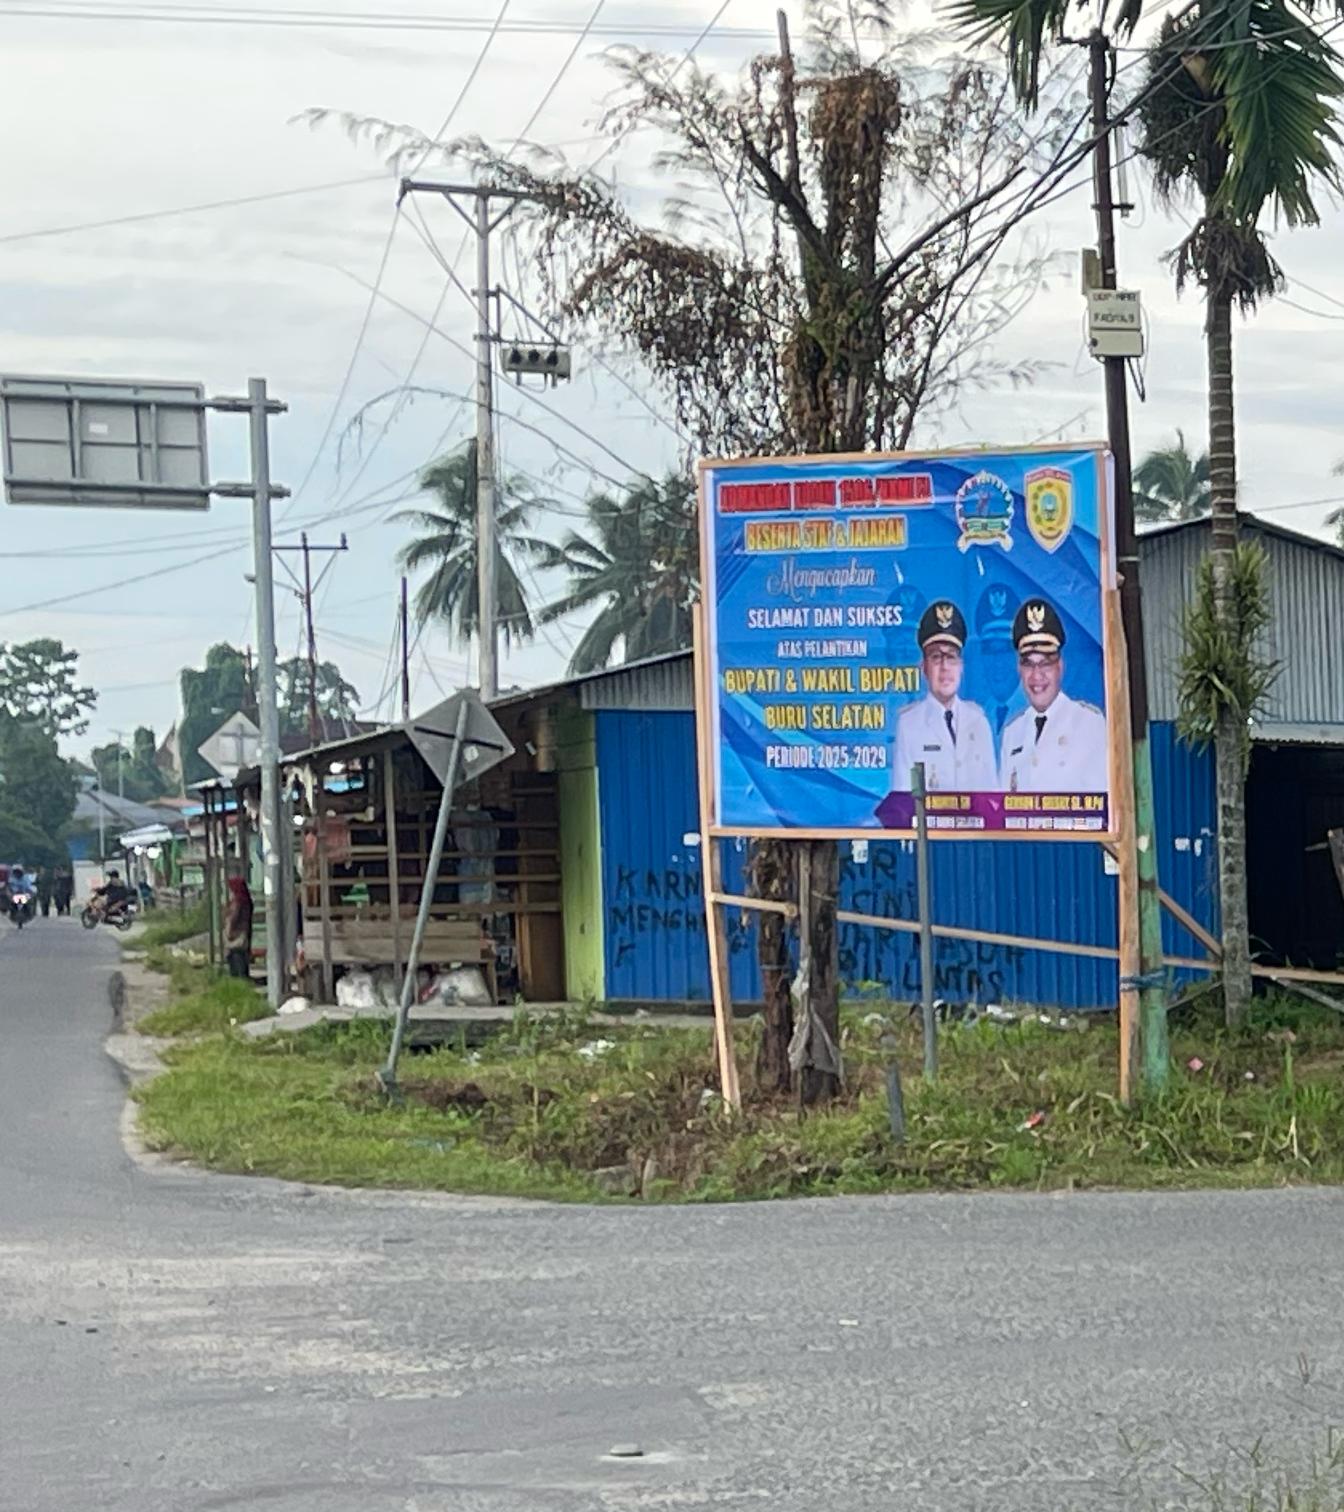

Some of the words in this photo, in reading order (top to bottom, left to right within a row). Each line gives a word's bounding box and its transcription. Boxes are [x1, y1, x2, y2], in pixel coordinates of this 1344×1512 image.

[836, 523, 847, 548] &
[748, 608, 810, 629] SELAMAT
[814, 608, 843, 628] DAN
[847, 605, 903, 627] SUKSES
[778, 640, 803, 658] ATAS
[725, 669, 781, 694] BUPATI
[786, 669, 798, 693] &
[802, 668, 856, 693] WAKIL
[860, 667, 921, 693] BUPATI
[766, 706, 807, 730] BURU
[811, 705, 886, 730] SELATAN
[766, 745, 816, 769] PERIODE
